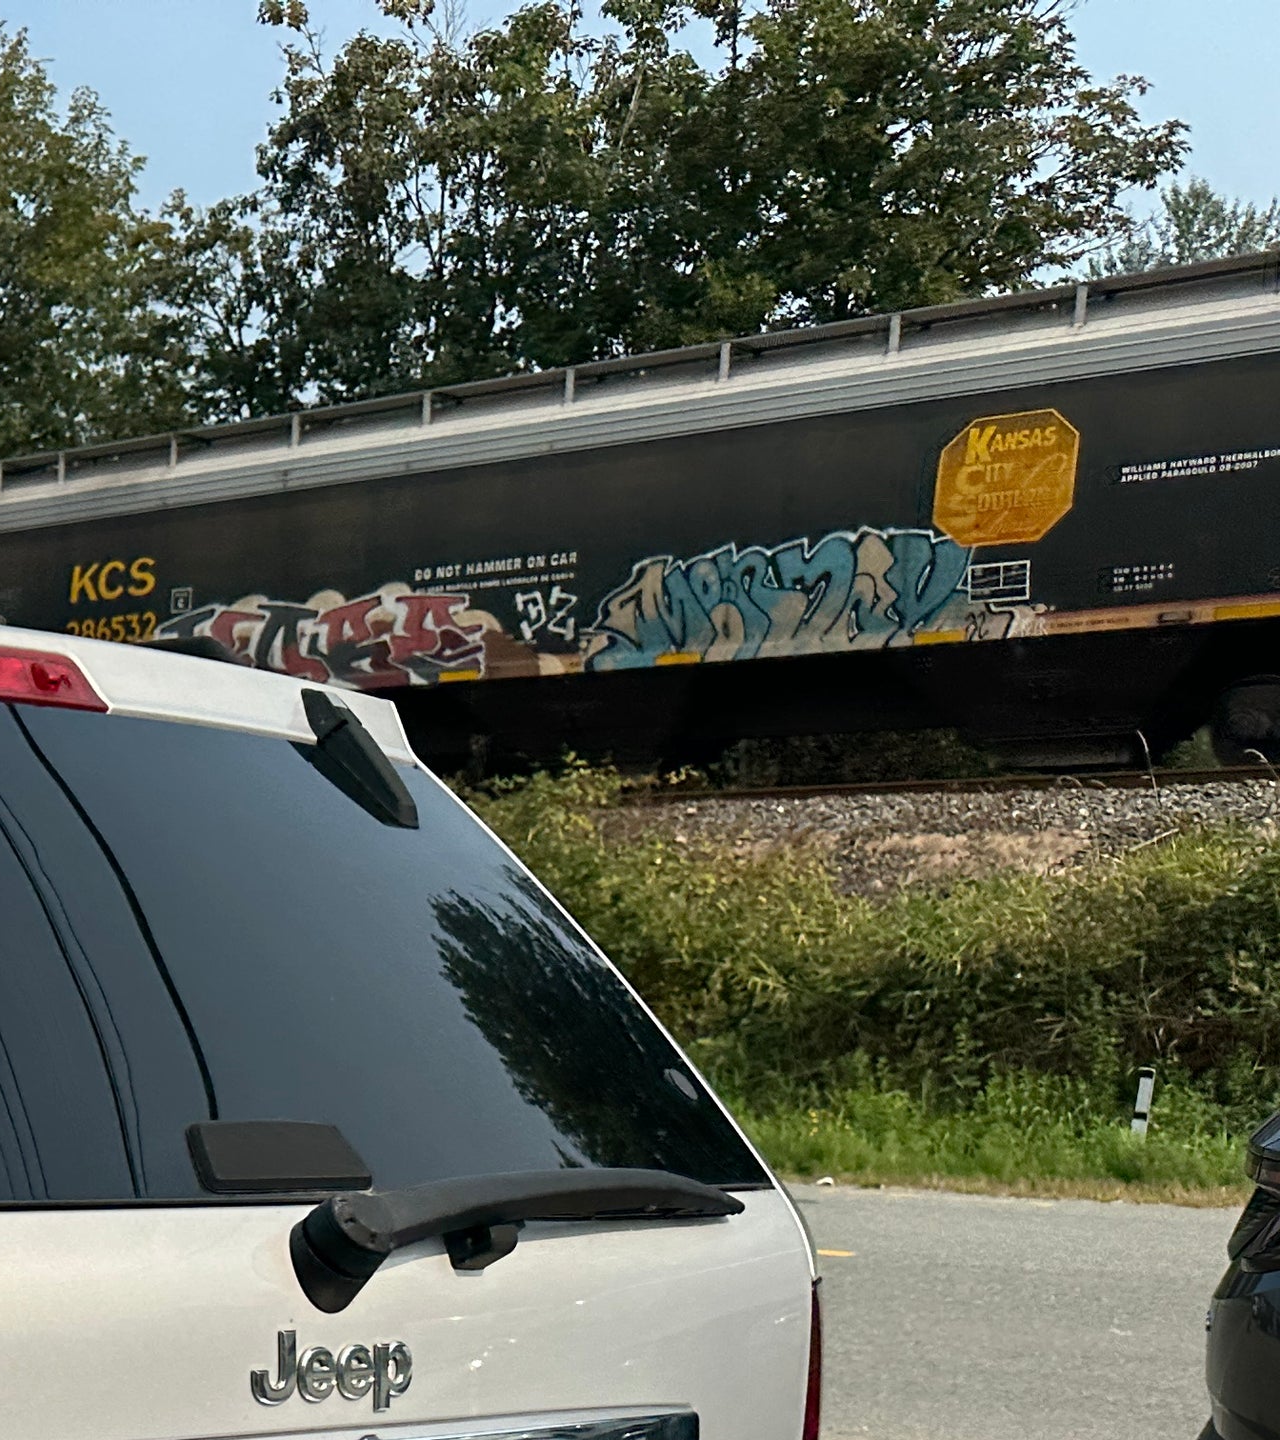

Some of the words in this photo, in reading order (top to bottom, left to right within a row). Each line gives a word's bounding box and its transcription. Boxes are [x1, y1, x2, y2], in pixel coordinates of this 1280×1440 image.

[965, 425, 1057, 464] KANSAS
[1121, 461, 1167, 474] WILLIAMS
[70, 557, 156, 604] KCS
[414, 567, 432, 582] DO
[436, 564, 462, 579] NOT
[466, 557, 522, 576] HAMMER
[527, 554, 546, 569] ON
[550, 551, 578, 566] CAR
[250, 1329, 413, 1413] Jeep
